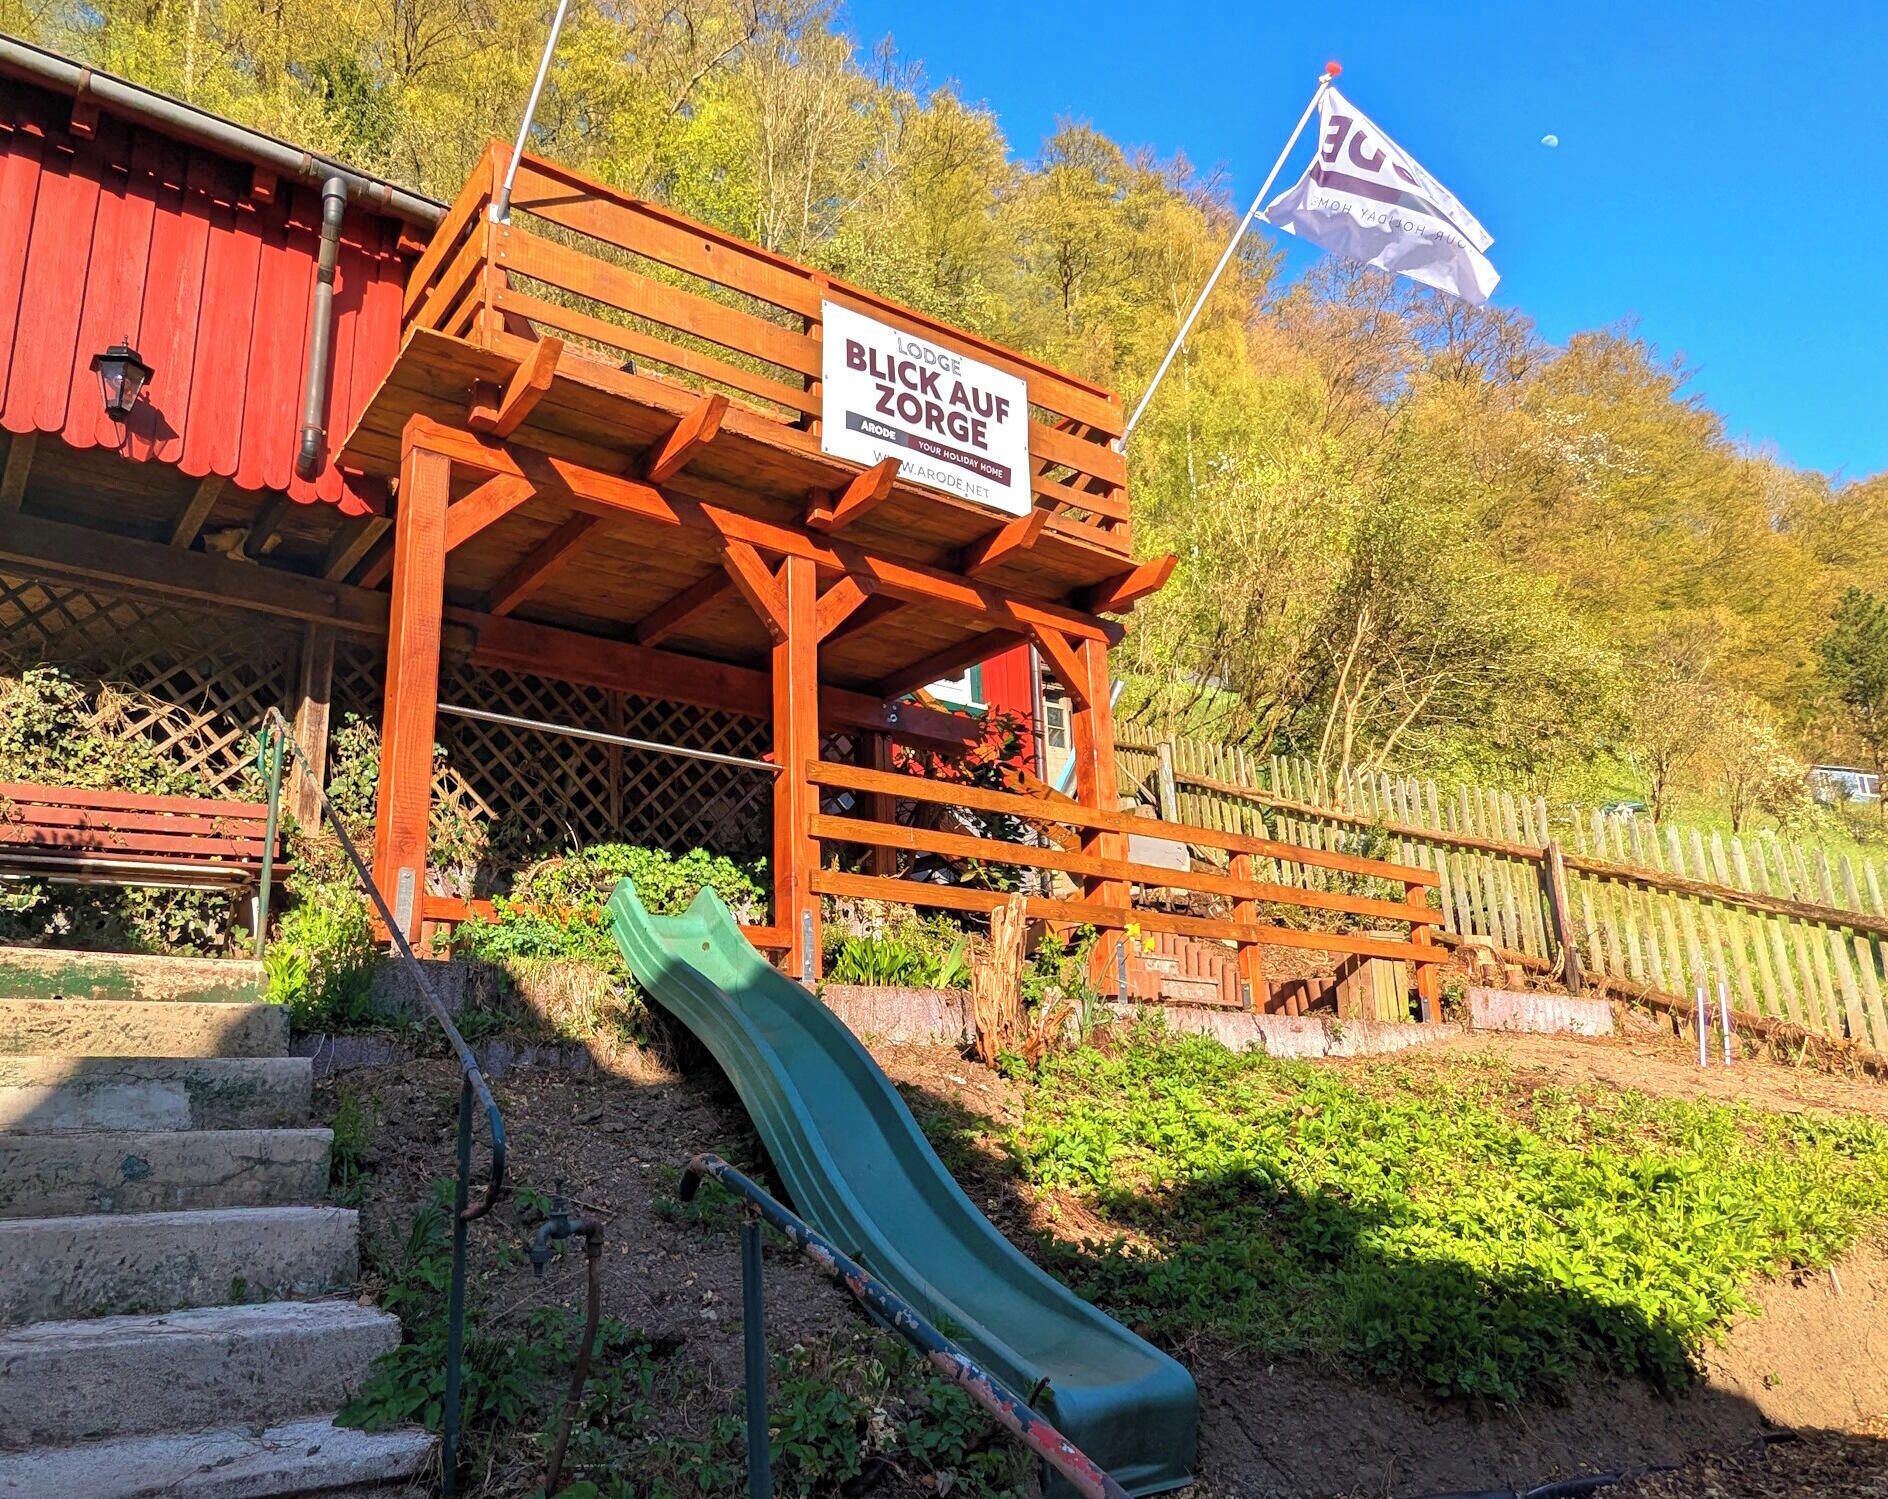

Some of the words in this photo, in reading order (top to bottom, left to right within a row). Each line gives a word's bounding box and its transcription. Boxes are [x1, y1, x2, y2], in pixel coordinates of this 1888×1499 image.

[846, 338, 943, 401] BLICK
[949, 380, 1010, 424] AUF
[897, 336, 962, 377] LODGE
[875, 382, 988, 451] ZORGE
[860, 420, 897, 441] ARODE
[918, 440, 942, 456] YOUR
[943, 449, 979, 468] HOLIDAY
[980, 460, 1004, 479] HOME
[873, 449, 990, 498] WW.ARODE.NET
